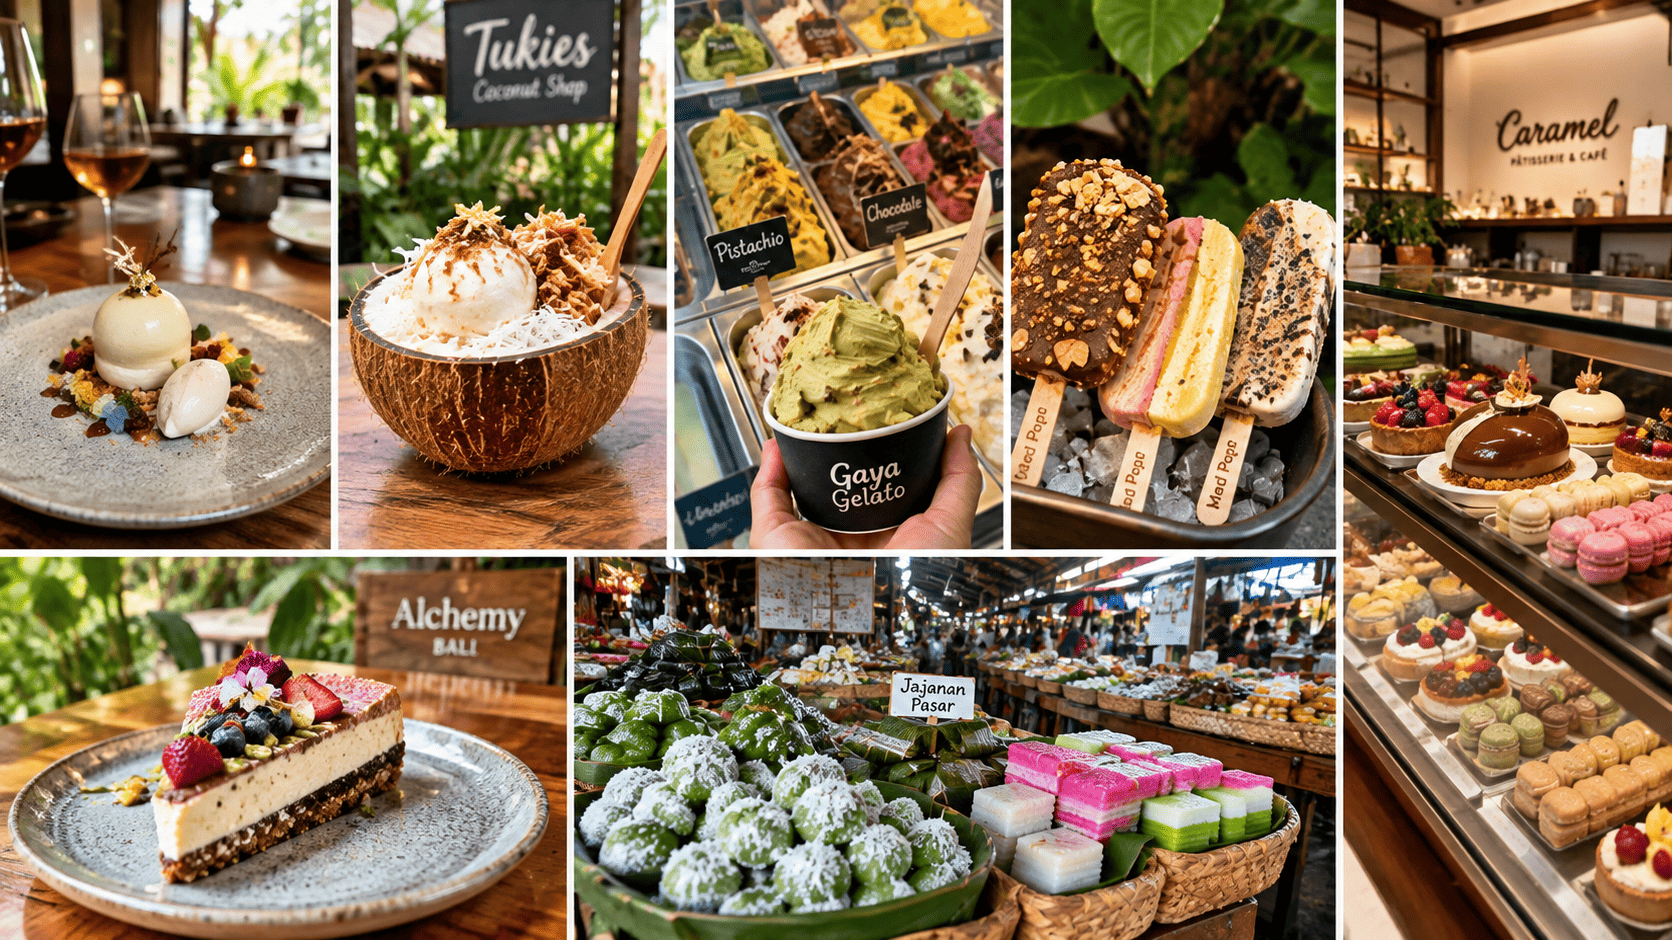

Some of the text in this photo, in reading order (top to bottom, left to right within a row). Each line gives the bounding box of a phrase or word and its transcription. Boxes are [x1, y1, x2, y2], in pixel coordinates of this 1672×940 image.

[463, 13, 599, 77] Tukies
[1496, 97, 1620, 152] Caramel
[1568, 153, 1576, 162] &
[1580, 147, 1608, 162] CAFÉ
[713, 232, 784, 263] Pistachio
[830, 462, 901, 491] Gaya
[832, 482, 905, 513] Gelato
[391, 596, 527, 641] Alchemy
[432, 637, 478, 657] BALI
[900, 677, 966, 698] Jajanan
[911, 697, 956, 712] Pasar
